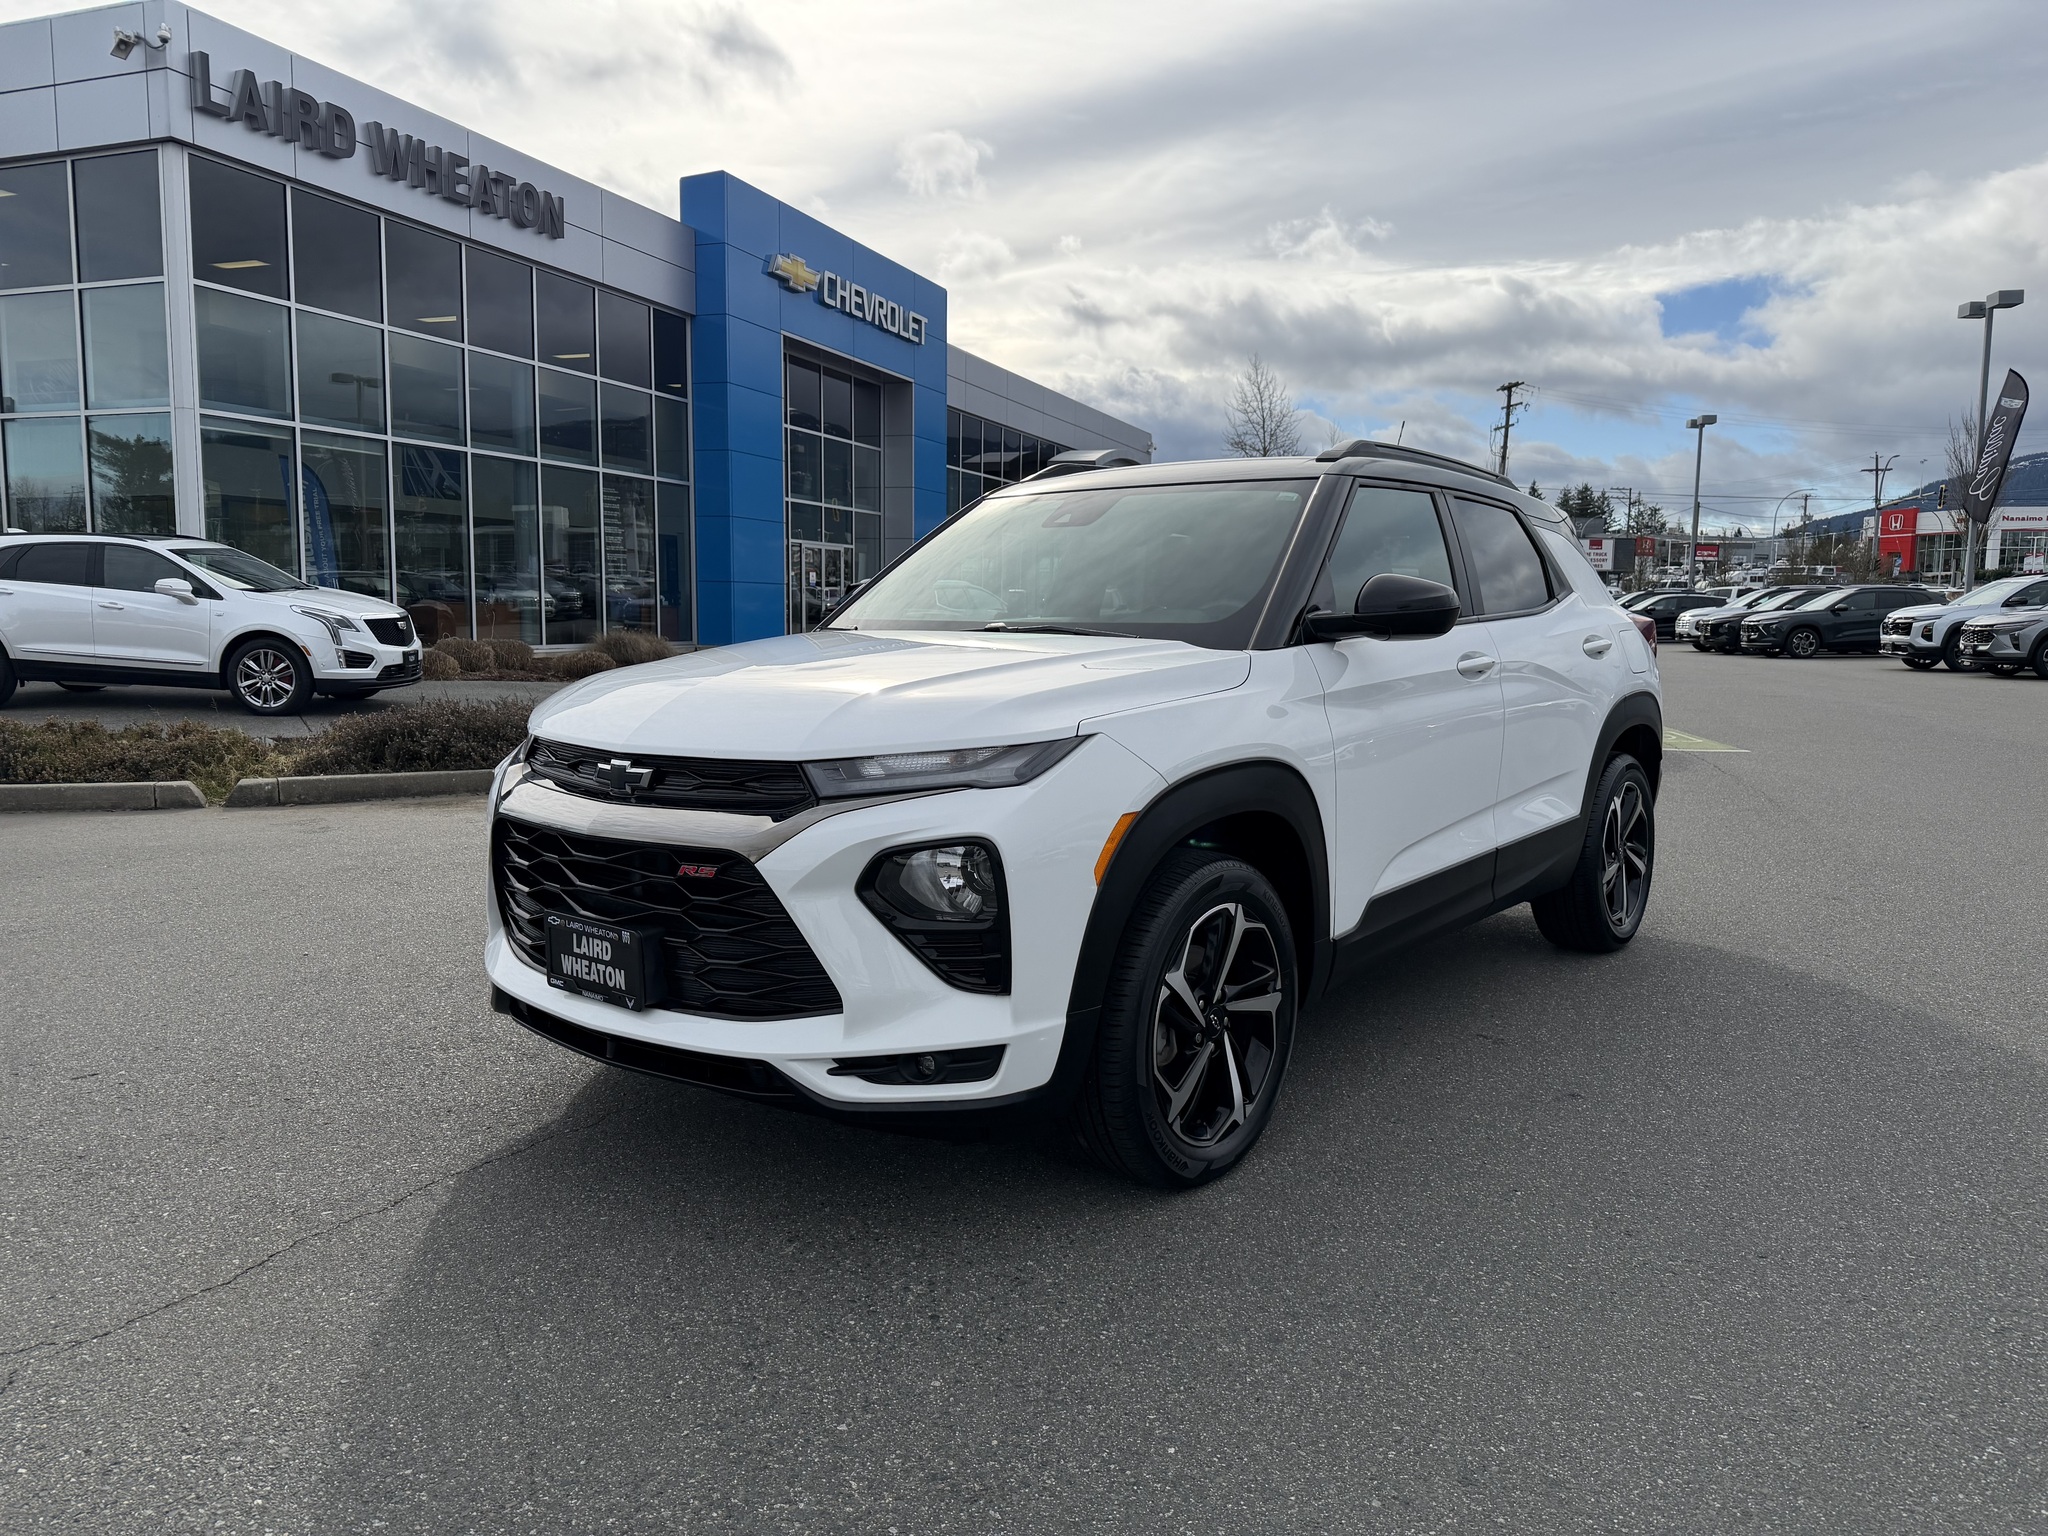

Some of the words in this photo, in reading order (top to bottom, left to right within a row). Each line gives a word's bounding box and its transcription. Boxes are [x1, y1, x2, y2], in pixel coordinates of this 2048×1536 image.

[191, 51, 356, 159] LAIRD
[366, 121, 565, 239] WHEATON
[822, 270, 929, 346] CHEVROLET
[312, 487, 320, 509] TRIAL
[314, 510, 323, 530] FREE
[318, 530, 327, 551] YOUR
[678, 865, 718, 878] RS
[565, 919, 584, 931] LAIRD
[584, 924, 616, 940] WHEATON
[572, 932, 612, 961] LAIRD
[549, 977, 564, 987] GMC
[560, 953, 626, 991] WHEATON
[581, 989, 604, 1001] NANAIMO
